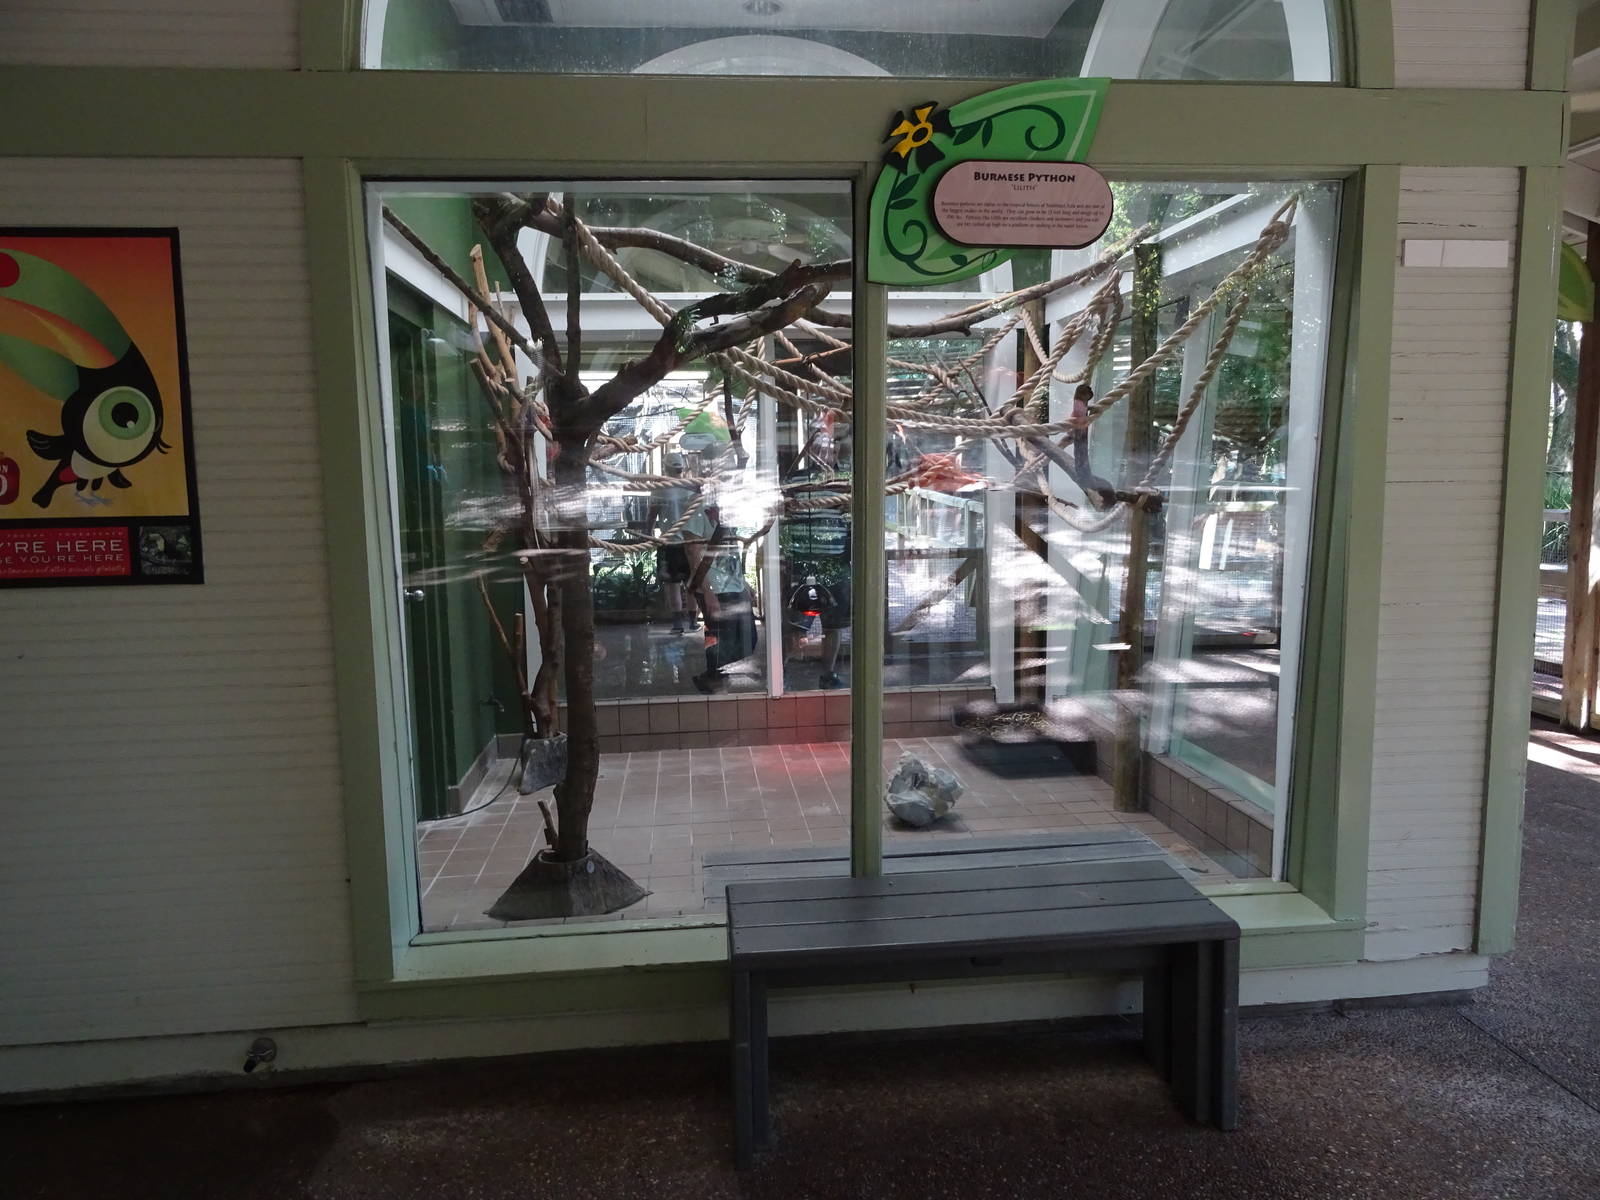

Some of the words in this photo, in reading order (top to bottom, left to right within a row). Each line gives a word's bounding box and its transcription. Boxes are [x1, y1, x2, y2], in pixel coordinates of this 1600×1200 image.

[974, 171, 1025, 182] BURMESE
[1028, 172, 1076, 182] PYTHON
[56, 539, 124, 553] HERE
[83, 554, 124, 562] HERE
